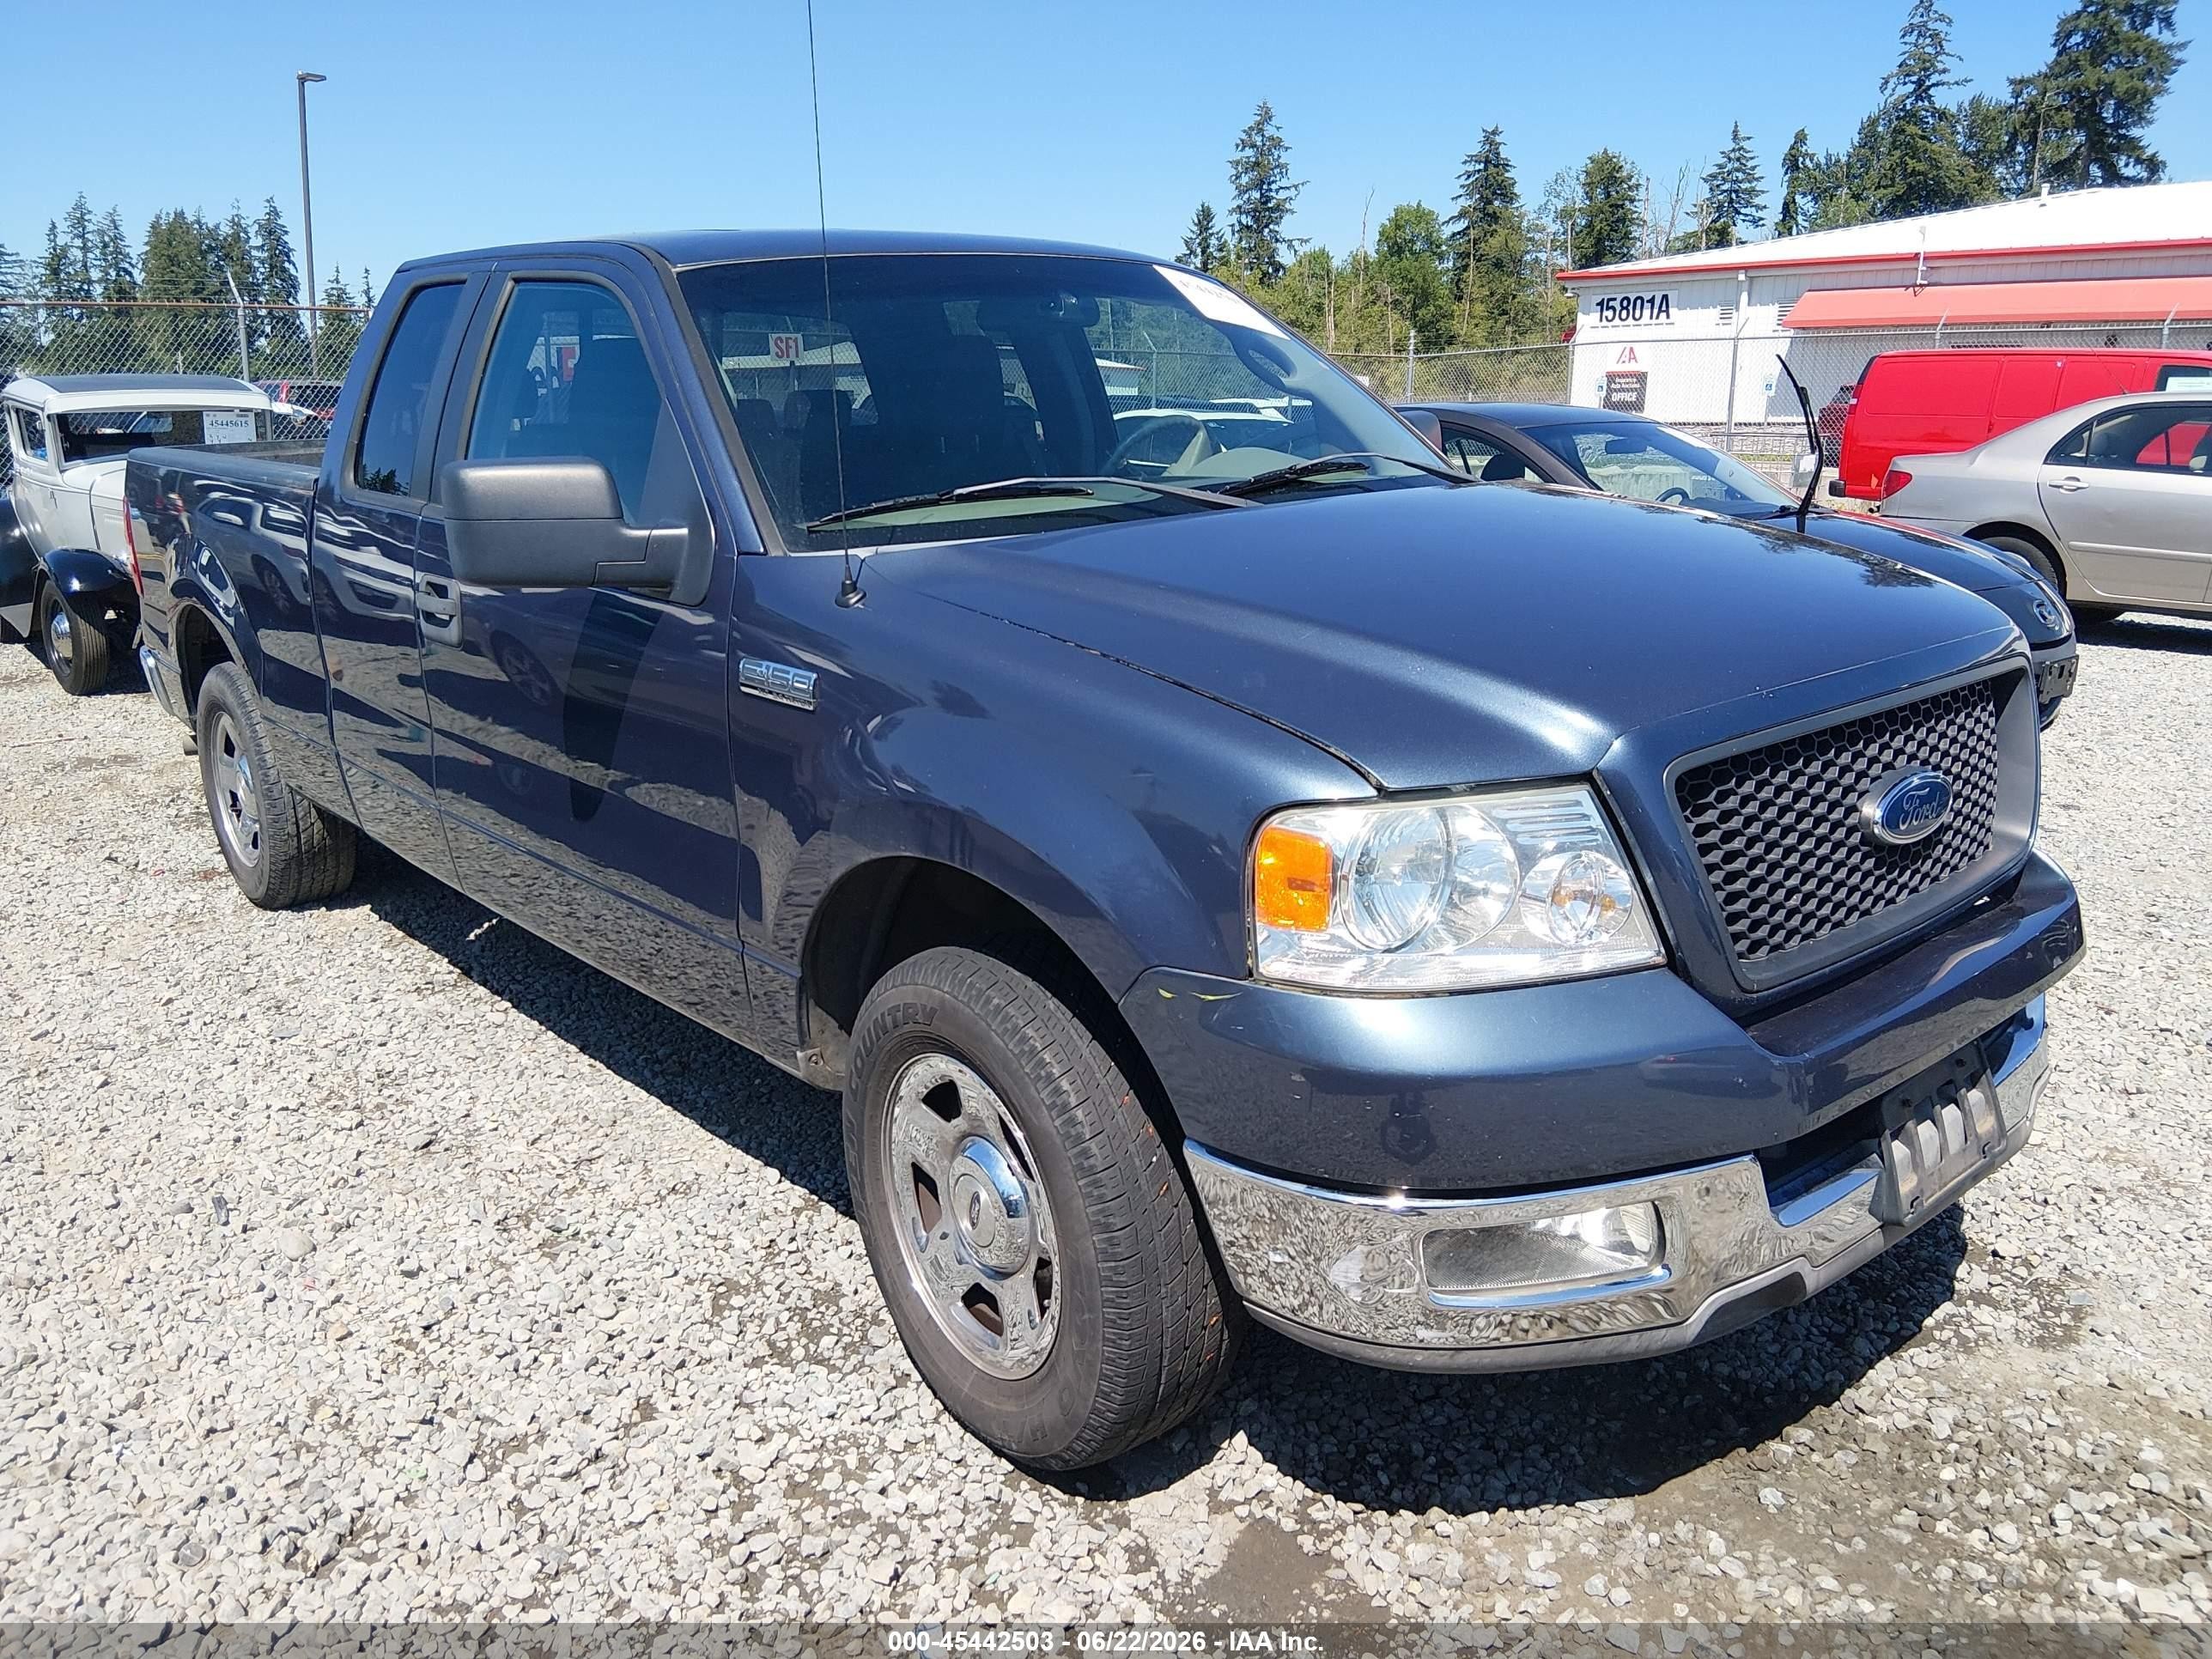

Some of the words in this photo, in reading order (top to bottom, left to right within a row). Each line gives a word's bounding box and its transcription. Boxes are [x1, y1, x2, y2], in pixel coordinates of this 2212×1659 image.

[1595, 294, 1670, 323] 15801A
[774, 336, 799, 359] SF1
[1612, 392, 1637, 401] OFFICE
[1899, 787, 1940, 830] Ford
[848, 1002, 939, 1103] COUNTRY
